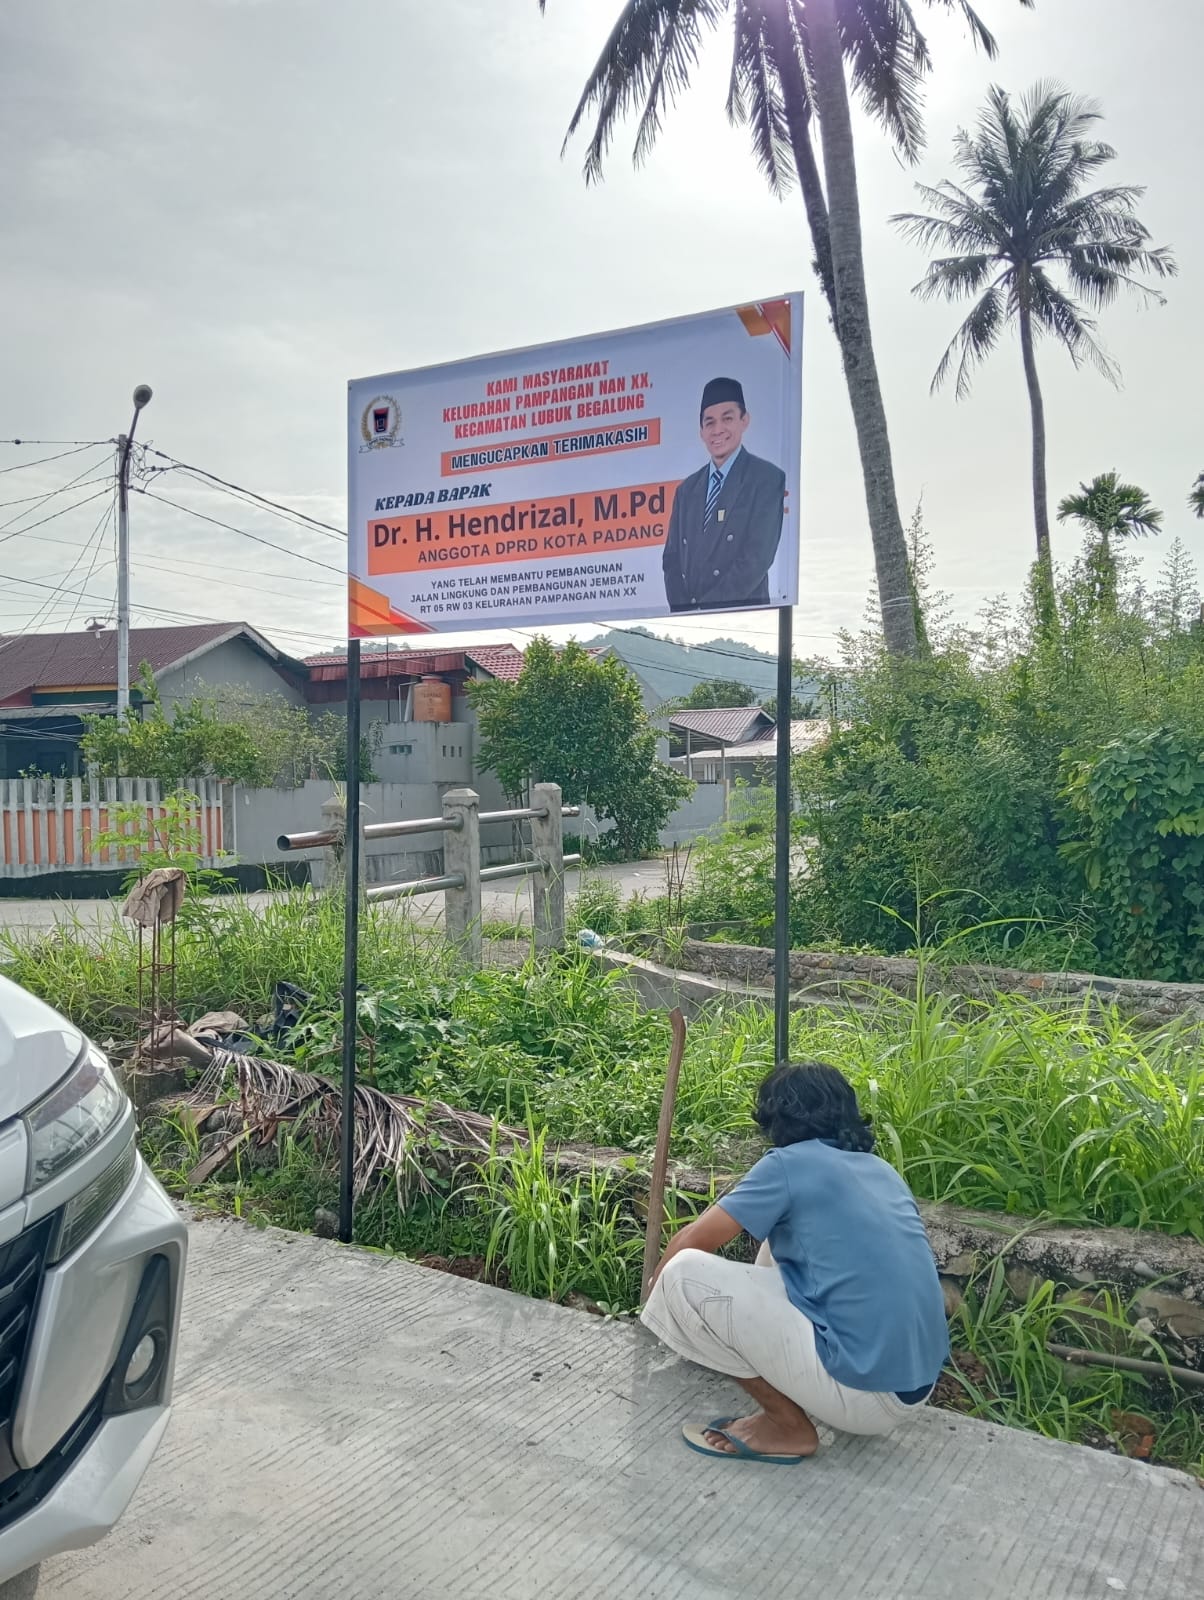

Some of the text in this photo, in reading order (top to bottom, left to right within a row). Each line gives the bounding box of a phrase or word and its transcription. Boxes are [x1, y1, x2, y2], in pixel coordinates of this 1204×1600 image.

[442, 372, 653, 423] KELURAHAN PAMPANGAN NAN XX,
[486, 360, 610, 397] KAMI MASYARAKAT
[454, 393, 645, 439] KECAMATAN LUBUK BEGALUNG
[451, 426, 648, 469] MENGUCAPKAN TERIMAKASIH
[374, 483, 492, 511] KEPADA BAPAK
[374, 486, 665, 548] Dr. H. Hendrizal, M.Pd
[418, 523, 664, 563] ANGGOTA DPRD KOTA PADANG
[410, 573, 645, 603] JALAN LINGKUNG DAN PEMBANGUNAN JEMBATAN
[431, 562, 623, 589] YANG TELAH MEMBANTU PEMBANGUNAN
[420, 586, 637, 614] RT 05 RW 03 KELURAHAN PAMPANGAN NAN XX
